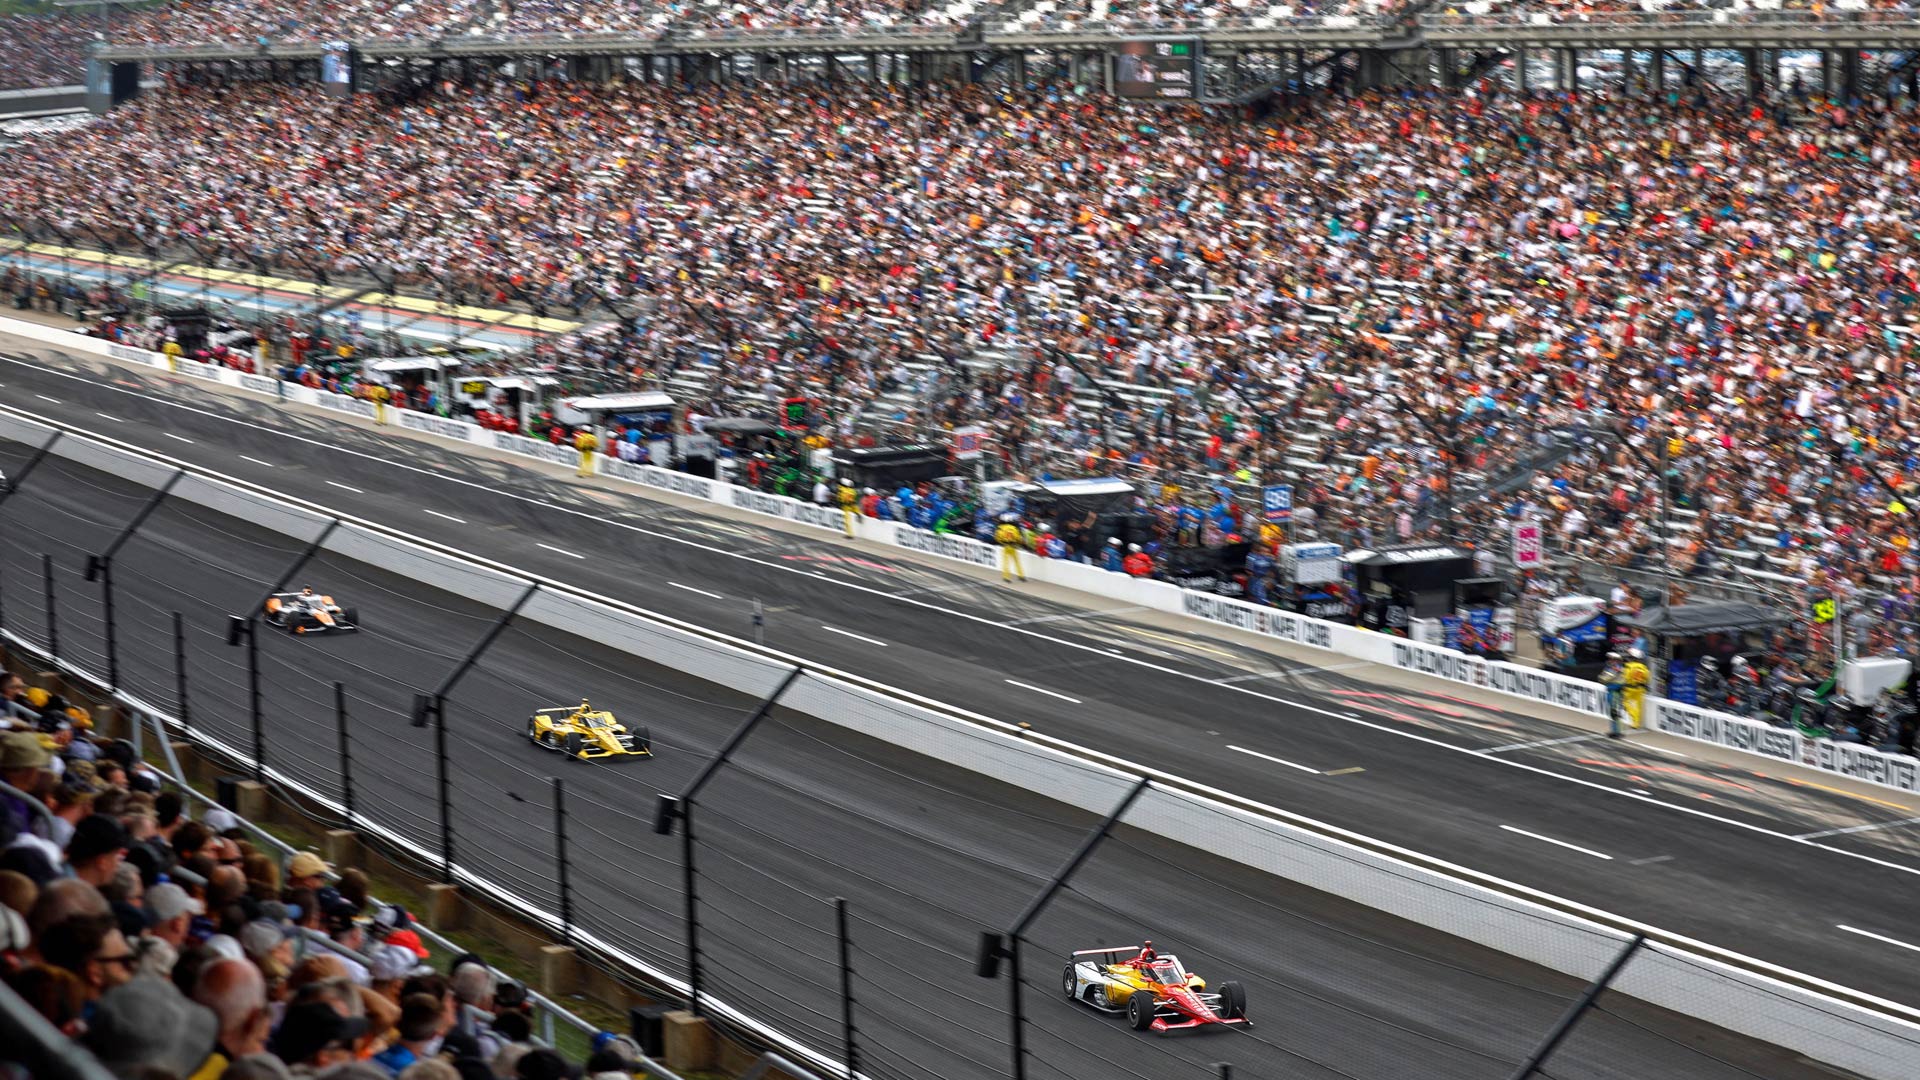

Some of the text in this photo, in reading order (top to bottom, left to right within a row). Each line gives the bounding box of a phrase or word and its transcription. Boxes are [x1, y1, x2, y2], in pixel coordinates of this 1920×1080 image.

[1392, 642, 1413, 669] TOM
[1657, 704, 1721, 744] CHRISTIAN
[1723, 719, 1799, 762] RASMUSSEN
[1821, 742, 1837, 771] ED
